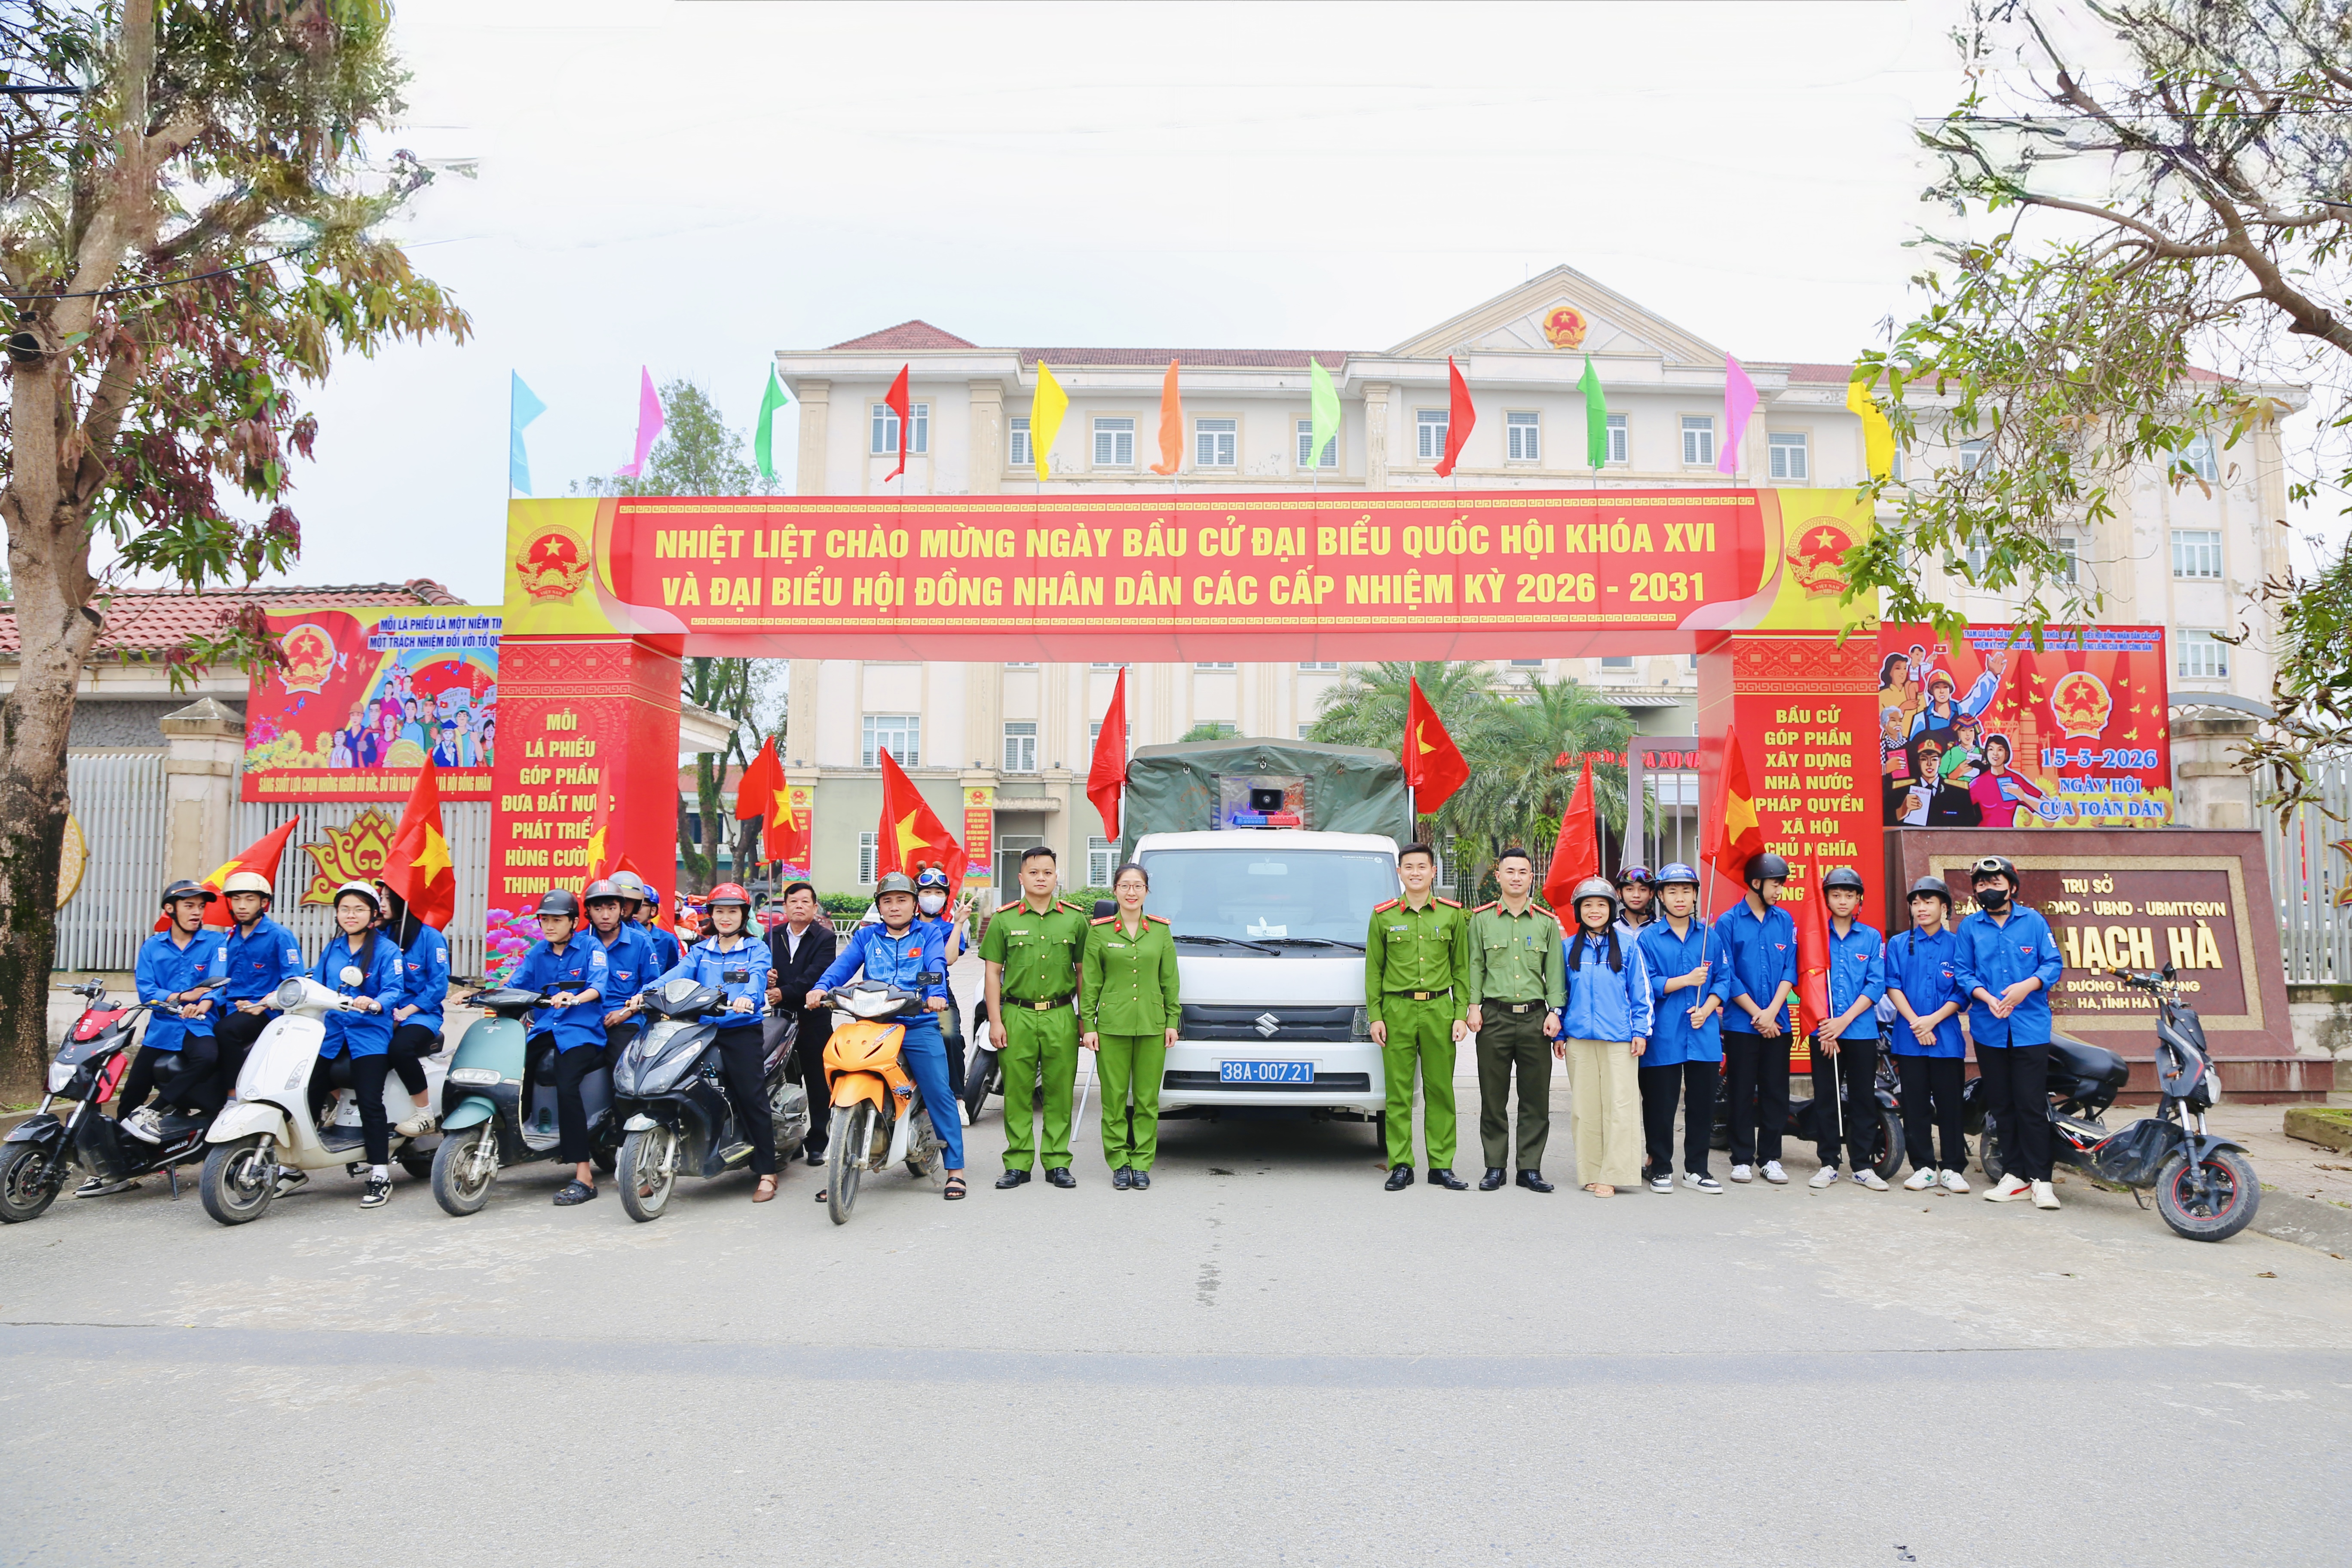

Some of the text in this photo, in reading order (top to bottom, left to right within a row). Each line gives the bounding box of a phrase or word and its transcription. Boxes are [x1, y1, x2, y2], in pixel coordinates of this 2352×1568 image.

[655, 514, 1715, 565] NHIỆT LIỆT CHÀO MỪNG NGÀY BẦU CỬ ĐẠI BIỂU QUỐC HỘI KHÓA XVI
[662, 571, 701, 606] VÀ
[709, 577, 761, 612] ĐẠI
[771, 565, 842, 606] BIỂU
[852, 571, 905, 612] HỘI
[914, 567, 1002, 606] ĐỒNG
[1013, 570, 1104, 606] NHÂN
[1115, 570, 1182, 606] DÂN
[1193, 570, 1258, 606] CÁC
[1269, 565, 1335, 605] CẤP
[1346, 568, 1453, 610] NHIỆM
[1464, 567, 1506, 603] KỲ
[1516, 573, 1596, 603] 2026
[1629, 572, 1703, 602] 2031
[380, 614, 396, 630] MỖI
[398, 615, 408, 630] LÁ
[410, 614, 434, 630] PHIẾU
[436, 615, 445, 629] LÀ
[448, 616, 466, 631] MỘT
[468, 613, 490, 629] NIỀM
[370, 634, 386, 650] MỘT
[389, 634, 413, 647] TRÁCH
[417, 634, 444, 650] NHIỆM
[447, 632, 459, 647] ĐỐI
[462, 633, 475, 646] VỚI
[546, 707, 577, 731] MỖI
[1776, 704, 1841, 723] BẦU CỬ
[525, 735, 596, 757] LÁ PHIẾU
[1764, 727, 1852, 745] GÓP PHẦN
[1765, 750, 1852, 770] XÂY DỰNG
[2042, 749, 2157, 769] 15-3-2026
[520, 762, 599, 785] GÓP PHẦN
[1765, 772, 1853, 790] NHÀ NƯỚC
[2059, 775, 2141, 796] NGÀY HỘI
[501, 793, 533, 812] ĐƯA
[537, 789, 568, 812] ĐẤT
[1756, 793, 1864, 813] PHÁP QUYỀN
[2040, 797, 2164, 816] CỦA TOÀN DÂN
[512, 815, 593, 839] PHÁT TRIỂ
[1782, 817, 1839, 837] XÃ HỘI
[505, 845, 588, 867] HÙNG CƯỜ
[1764, 836, 1799, 857] CHỦ
[503, 876, 586, 898] THỊNH VƯỢ
[2061, 873, 2114, 897] TRỤ SỞ
[2092, 900, 2133, 916] UBND
[2145, 900, 2226, 917] UBMTTQVN
[2055, 919, 2223, 976] HẠCH HÀ
[2131, 995, 2152, 1009] HÀ
[1223, 1063, 1310, 1081] 38A-007.21
